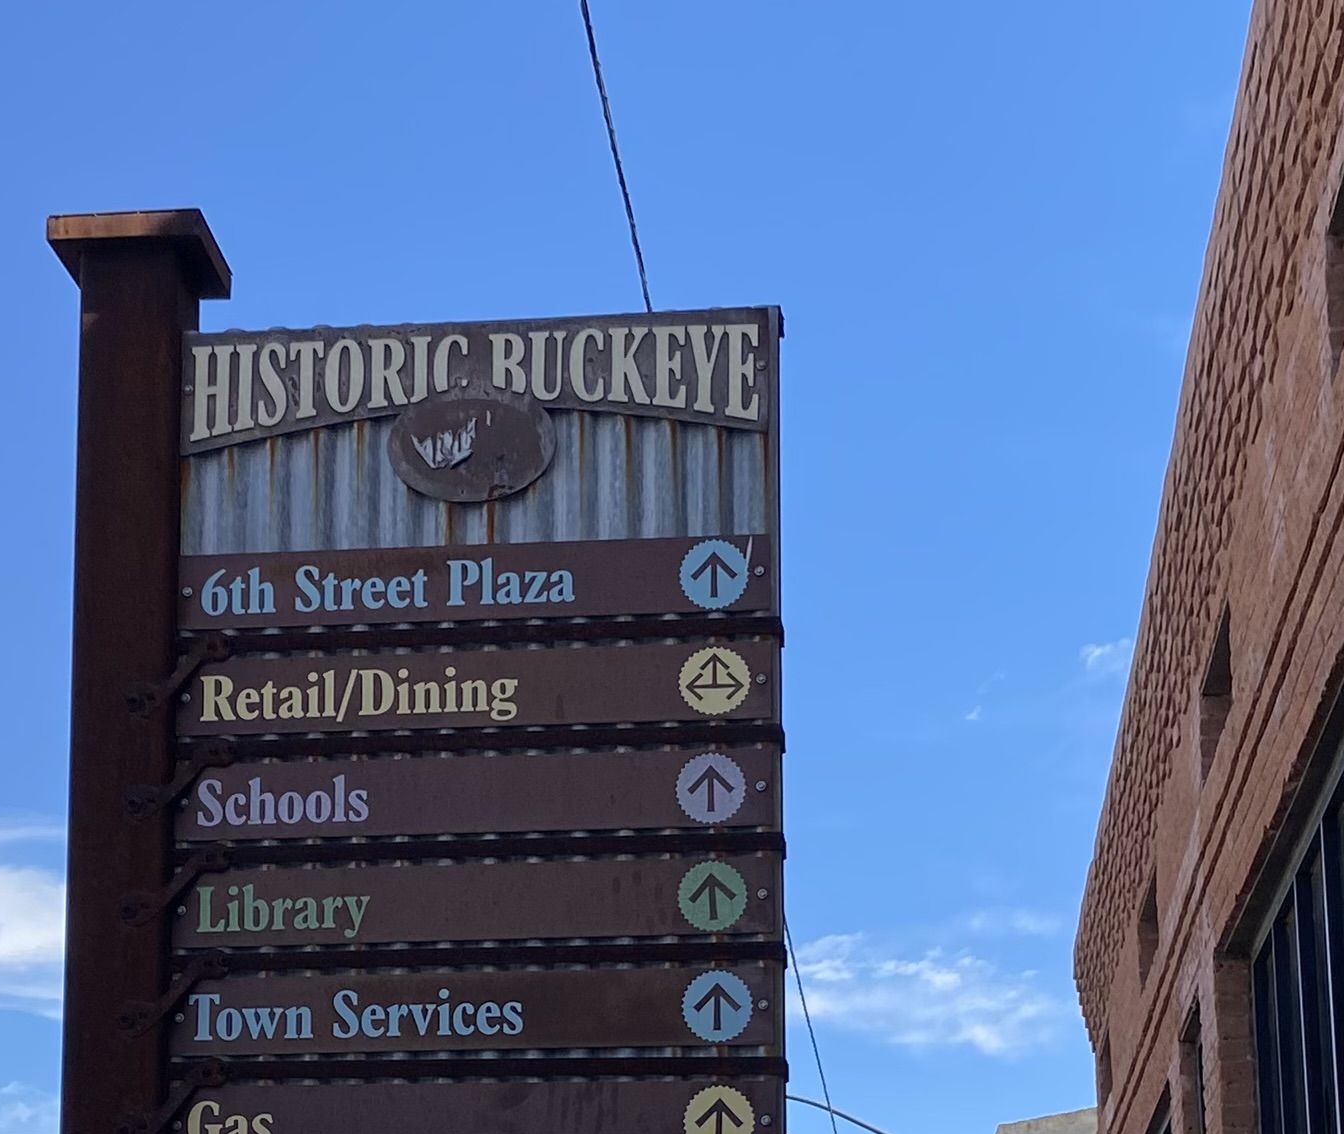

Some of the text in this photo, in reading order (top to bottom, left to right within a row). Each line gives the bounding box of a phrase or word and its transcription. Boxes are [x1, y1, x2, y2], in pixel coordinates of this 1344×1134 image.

[190, 324, 760, 442] HISTORIC BUCKEYE
[200, 557, 575, 617] 6th Street Plaza
[199, 666, 518, 723] Retail/Dining
[195, 774, 370, 827] Schools
[195, 883, 370, 938] Library
[188, 988, 525, 1042] Town Services
